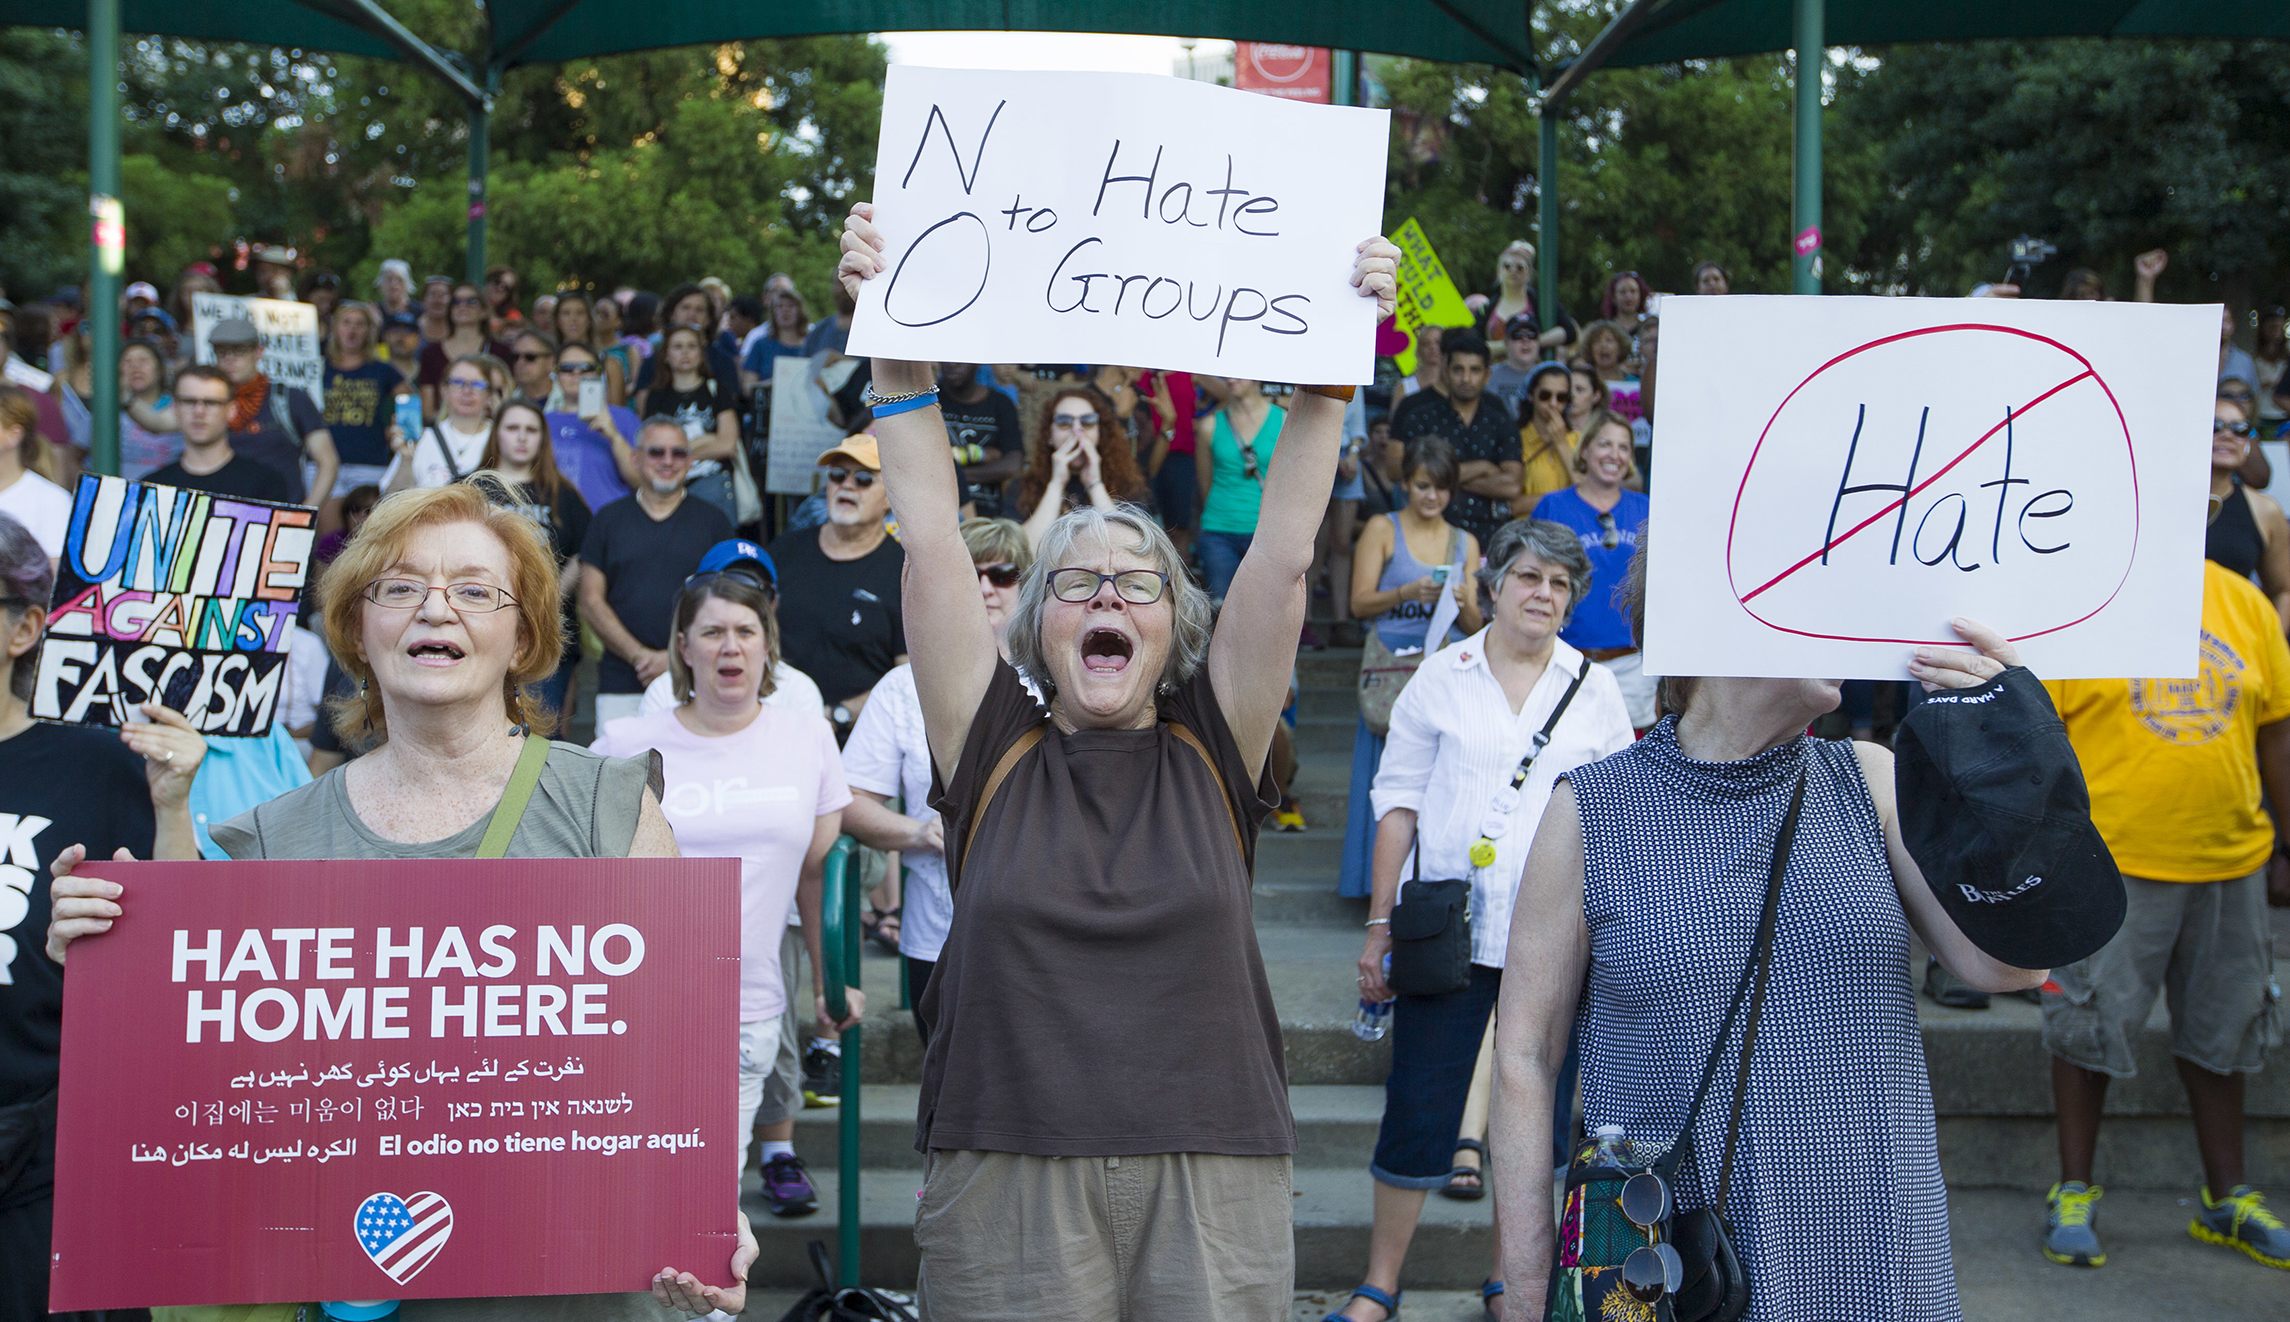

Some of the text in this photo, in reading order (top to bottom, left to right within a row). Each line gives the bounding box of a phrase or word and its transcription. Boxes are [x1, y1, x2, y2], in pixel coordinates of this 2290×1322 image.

[1093, 139, 1279, 237] Hate
[1001, 194, 1058, 233] to
[1402, 224, 1443, 281] WHAT
[1046, 236, 1311, 358] Groups
[198, 301, 222, 318] WE
[265, 307, 301, 329] NOT
[1821, 403, 2074, 572] Hate
[67, 474, 312, 600] UNITE
[46, 584, 299, 652] AGAINST
[33, 638, 284, 735] FASCISM
[1927, 684, 2004, 704] A HARD DAYS
[171, 923, 646, 983] HATE HAS NO
[186, 983, 628, 1043] HOME HERE.
[230, 1070, 255, 1088] ہے
[258, 1062, 309, 1088] نہیں
[414, 1059, 460, 1085] یہاں
[533, 1056, 584, 1082] نفرت
[289, 1096, 362, 1124] 미움이
[374, 1095, 425, 1121] 없다
[447, 1091, 633, 1122] לשנאה אין בית כאן
[131, 1137, 357, 1167] الكره ليس له مكان هنا
[379, 1127, 706, 1156] El odio no tiene hogar aquí.
